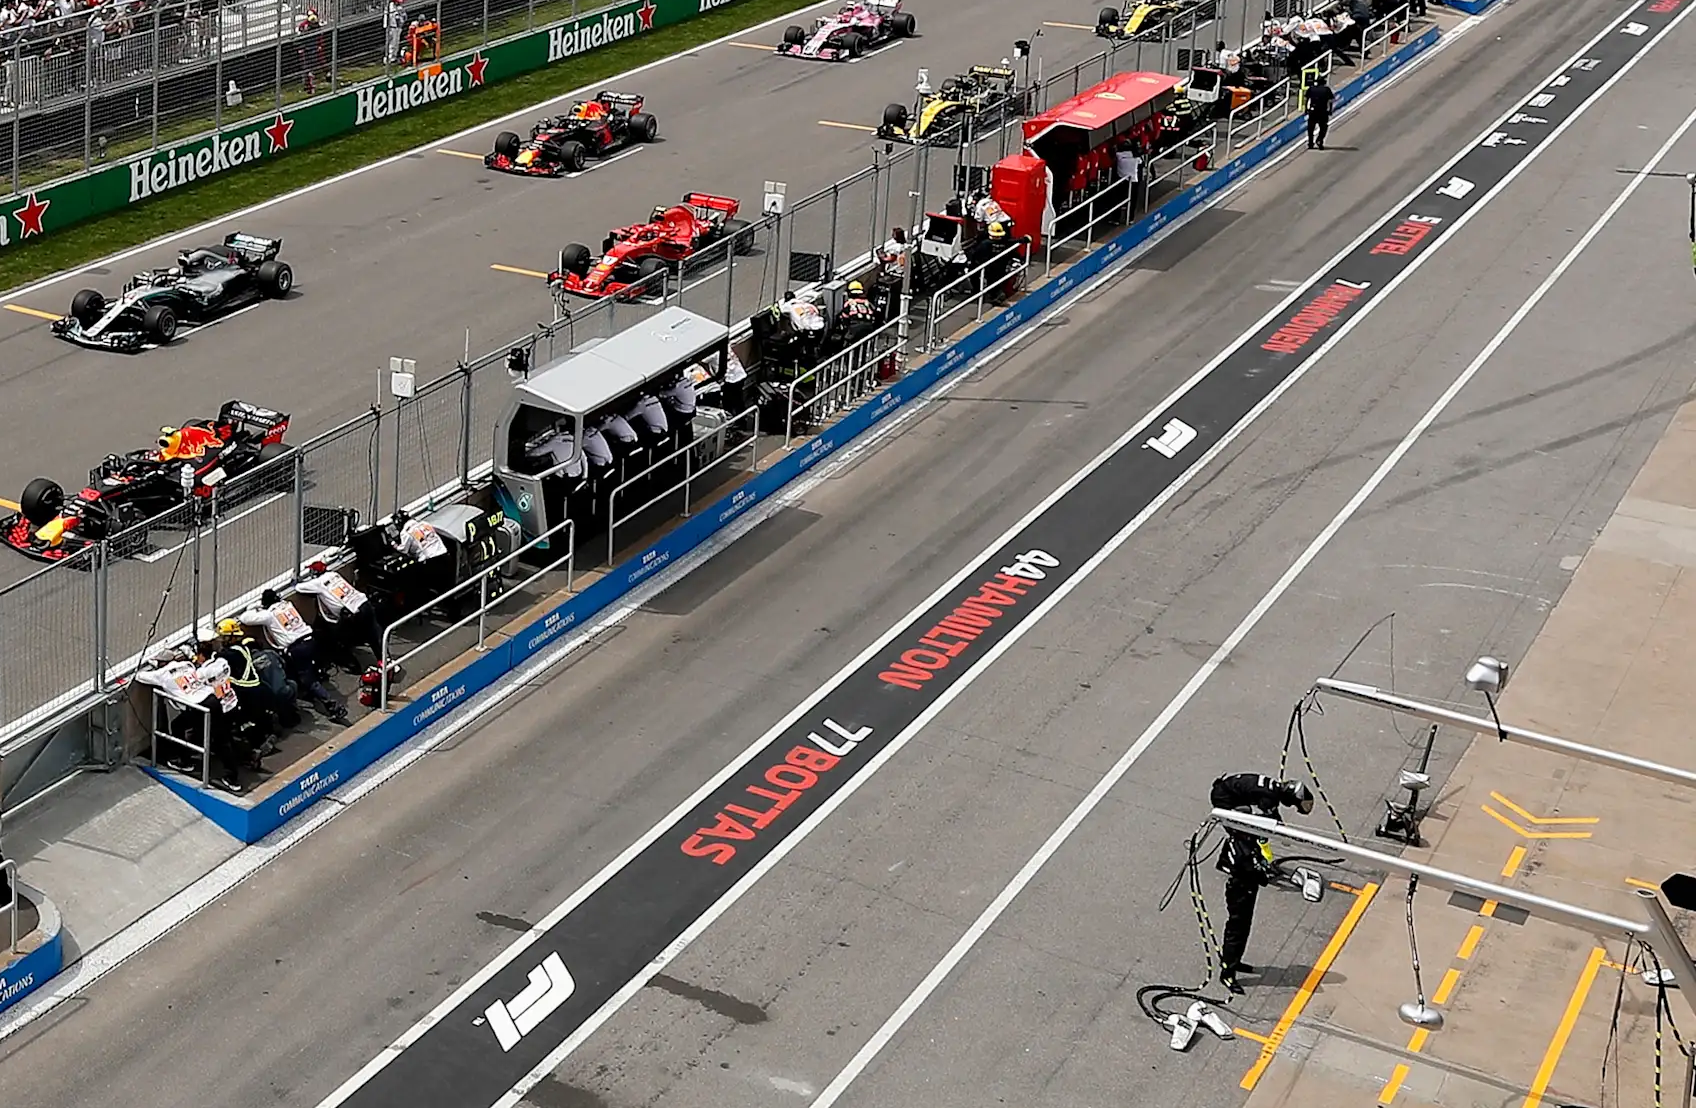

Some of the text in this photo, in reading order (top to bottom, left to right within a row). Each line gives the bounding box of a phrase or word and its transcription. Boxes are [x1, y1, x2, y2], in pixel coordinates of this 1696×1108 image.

[548, 10, 636, 63] Heineken
[355, 65, 463, 127] Heineken
[128, 128, 262, 203] Heineken
[878, 549, 1061, 690] 44 HAMILTON
[413, 685, 466, 726] COMMUNICATIONS
[431, 686, 449, 703] TATA
[279, 770, 340, 816] COMMUNICATIONS
[299, 772, 320, 790] TATA
[680, 718, 874, 865] 77 BOTTAS
